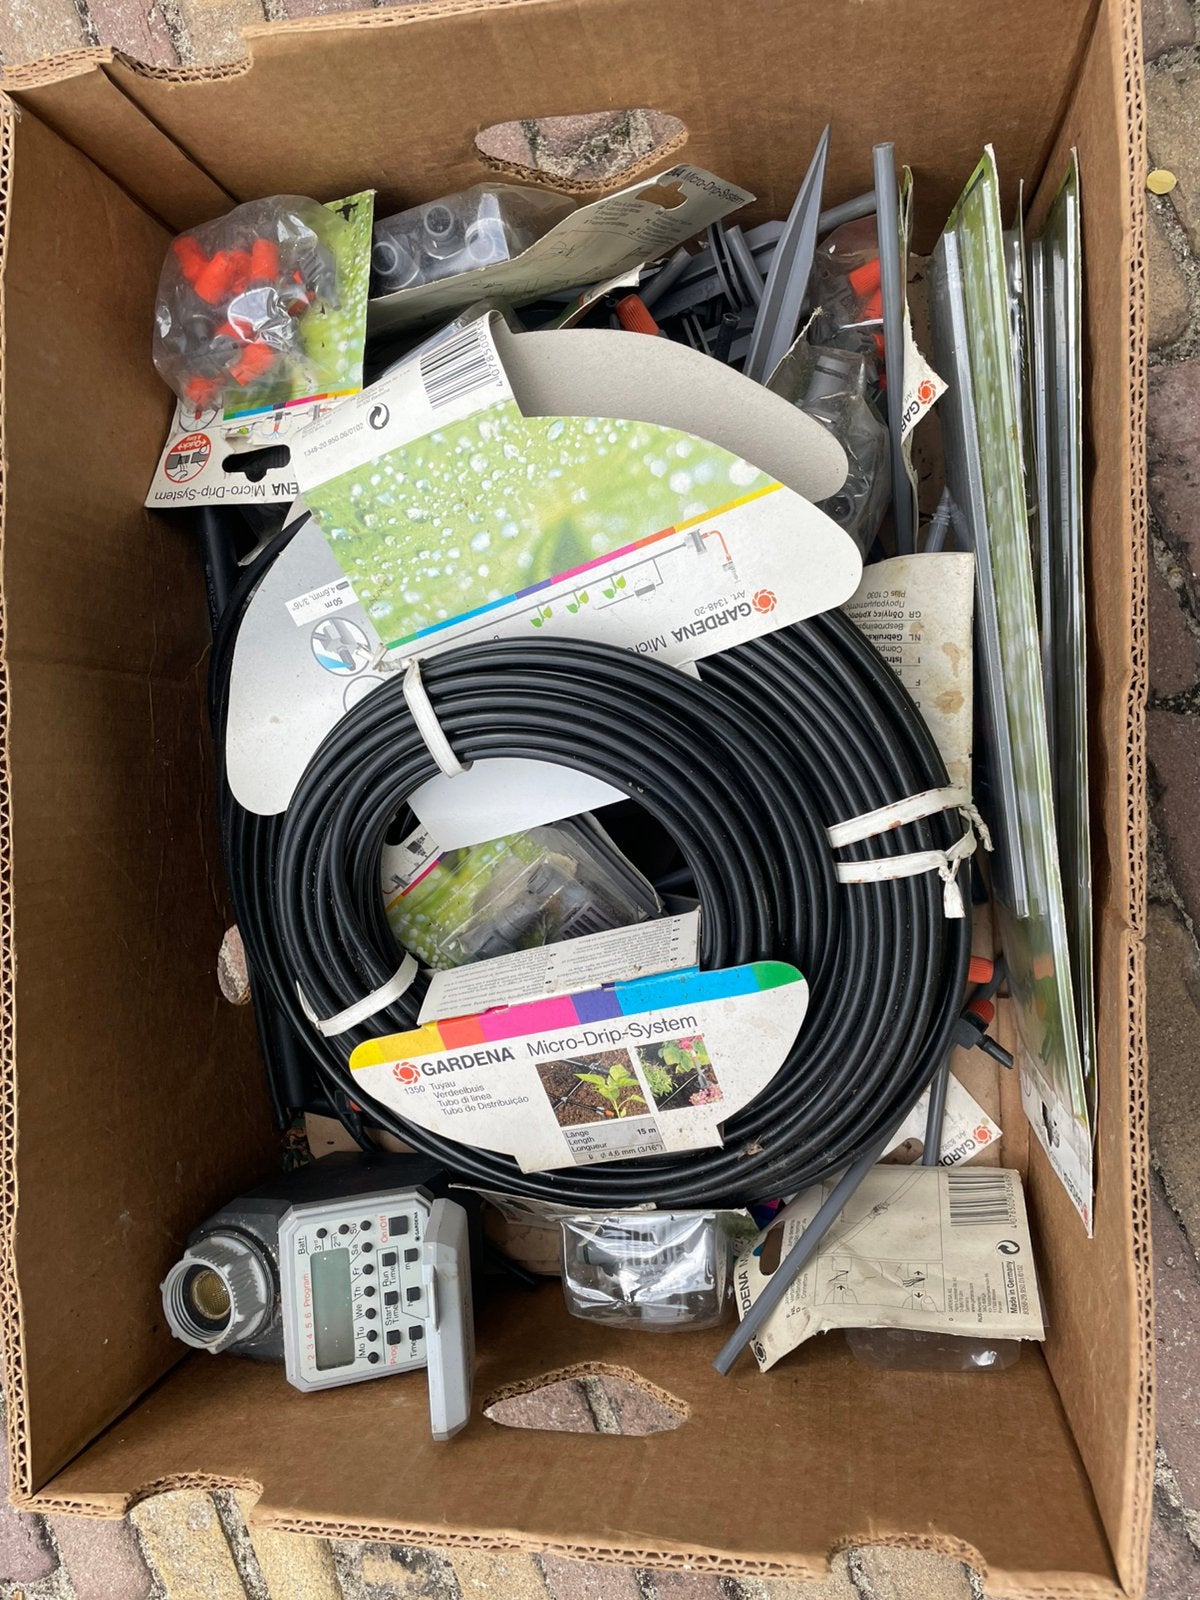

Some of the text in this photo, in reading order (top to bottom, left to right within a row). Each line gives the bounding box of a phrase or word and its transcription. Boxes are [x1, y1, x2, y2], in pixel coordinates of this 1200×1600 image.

[155, 484, 266, 501] Micro-Drip-System
[333, 597, 343, 607] 50
[694, 590, 746, 617] Art. 1348-20
[867, 591, 881, 599] 1030
[671, 602, 751, 642] GARDENA
[421, 1016, 698, 1076] GARDENA Micro-Drip-System
[404, 1080, 456, 1095] 1350 Tuyau
[433, 1084, 485, 1099] Verdeelbuis
[437, 1099, 459, 1108] Tubo
[470, 1093, 492, 1103] linea
[442, 1095, 529, 1116] Tubo de Distribuição
[568, 1136, 595, 1145] Length
[571, 1142, 607, 1153] Longueur
[380, 1215, 388, 1243] On/Off
[1006, 1261, 1015, 1291] Germany
[303, 1273, 313, 1307] Program
[350, 1223, 366, 1356] Mo Tu We Th Fr Sa Su
[1009, 1298, 1018, 1314] Made
[390, 1344, 398, 1366] Prog
